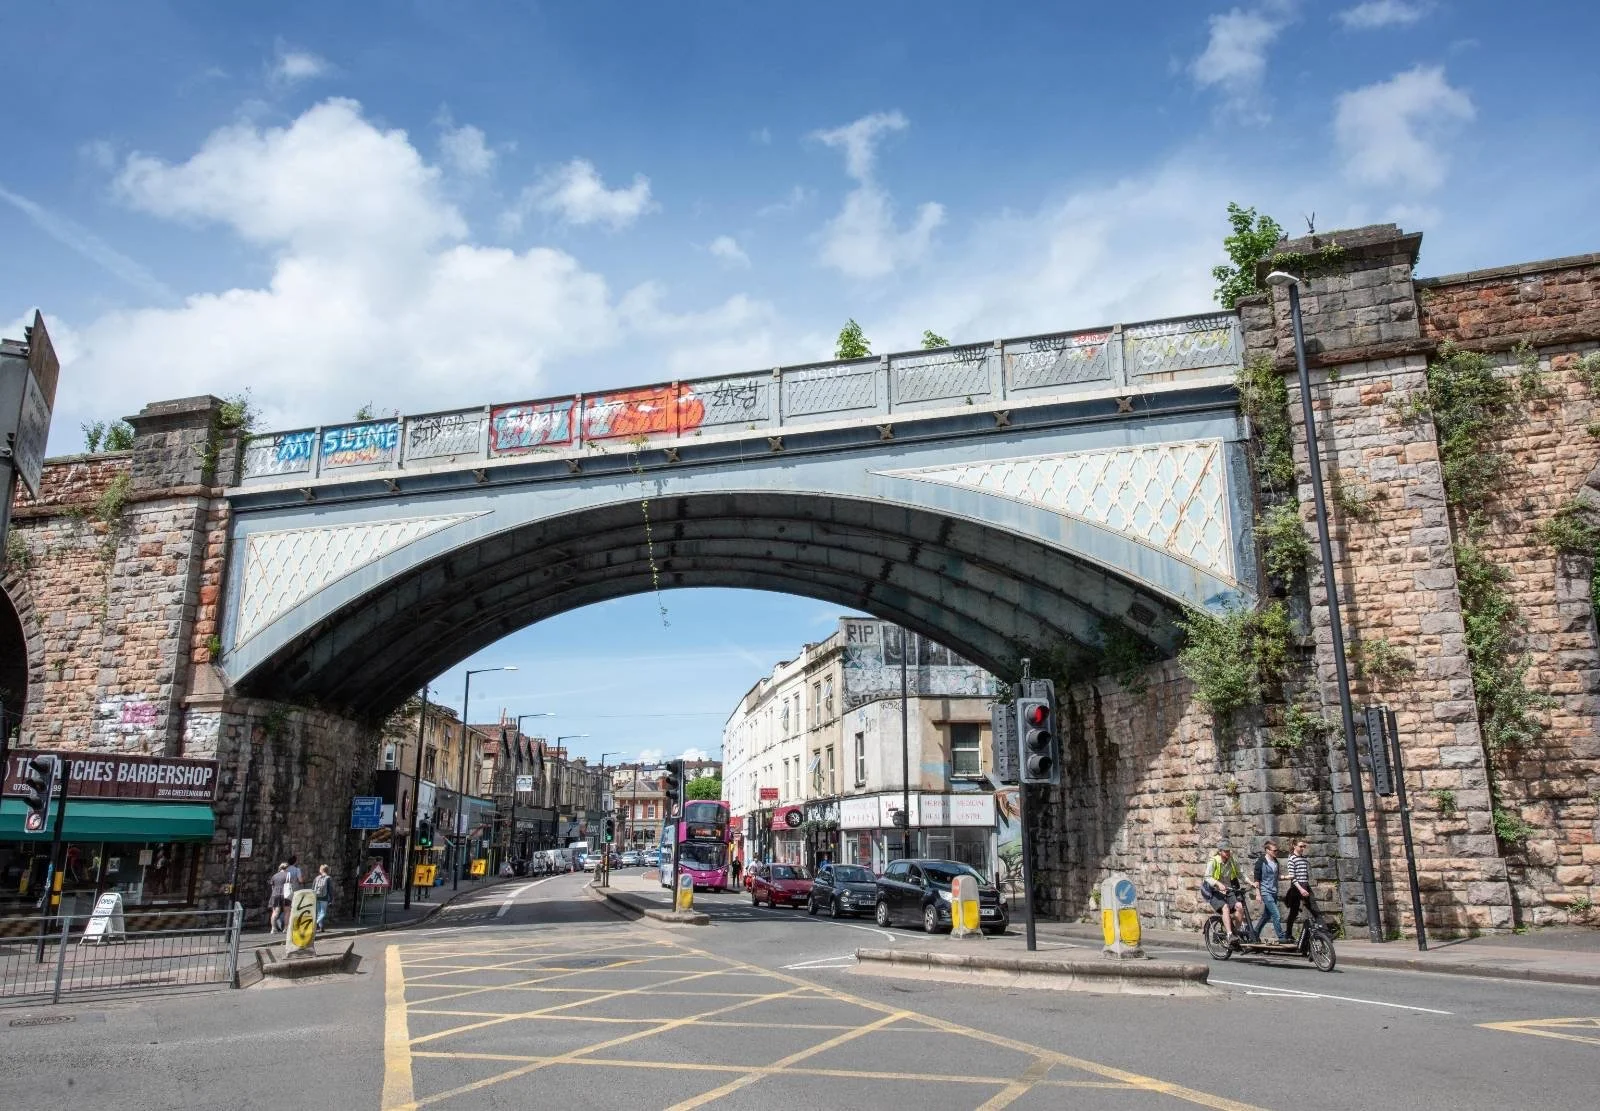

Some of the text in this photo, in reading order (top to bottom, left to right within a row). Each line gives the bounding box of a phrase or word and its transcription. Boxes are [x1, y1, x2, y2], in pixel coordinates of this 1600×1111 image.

[322, 422, 398, 455] SLIME
[847, 624, 874, 643] RIP
[116, 762, 213, 786] BARBERSHOP
